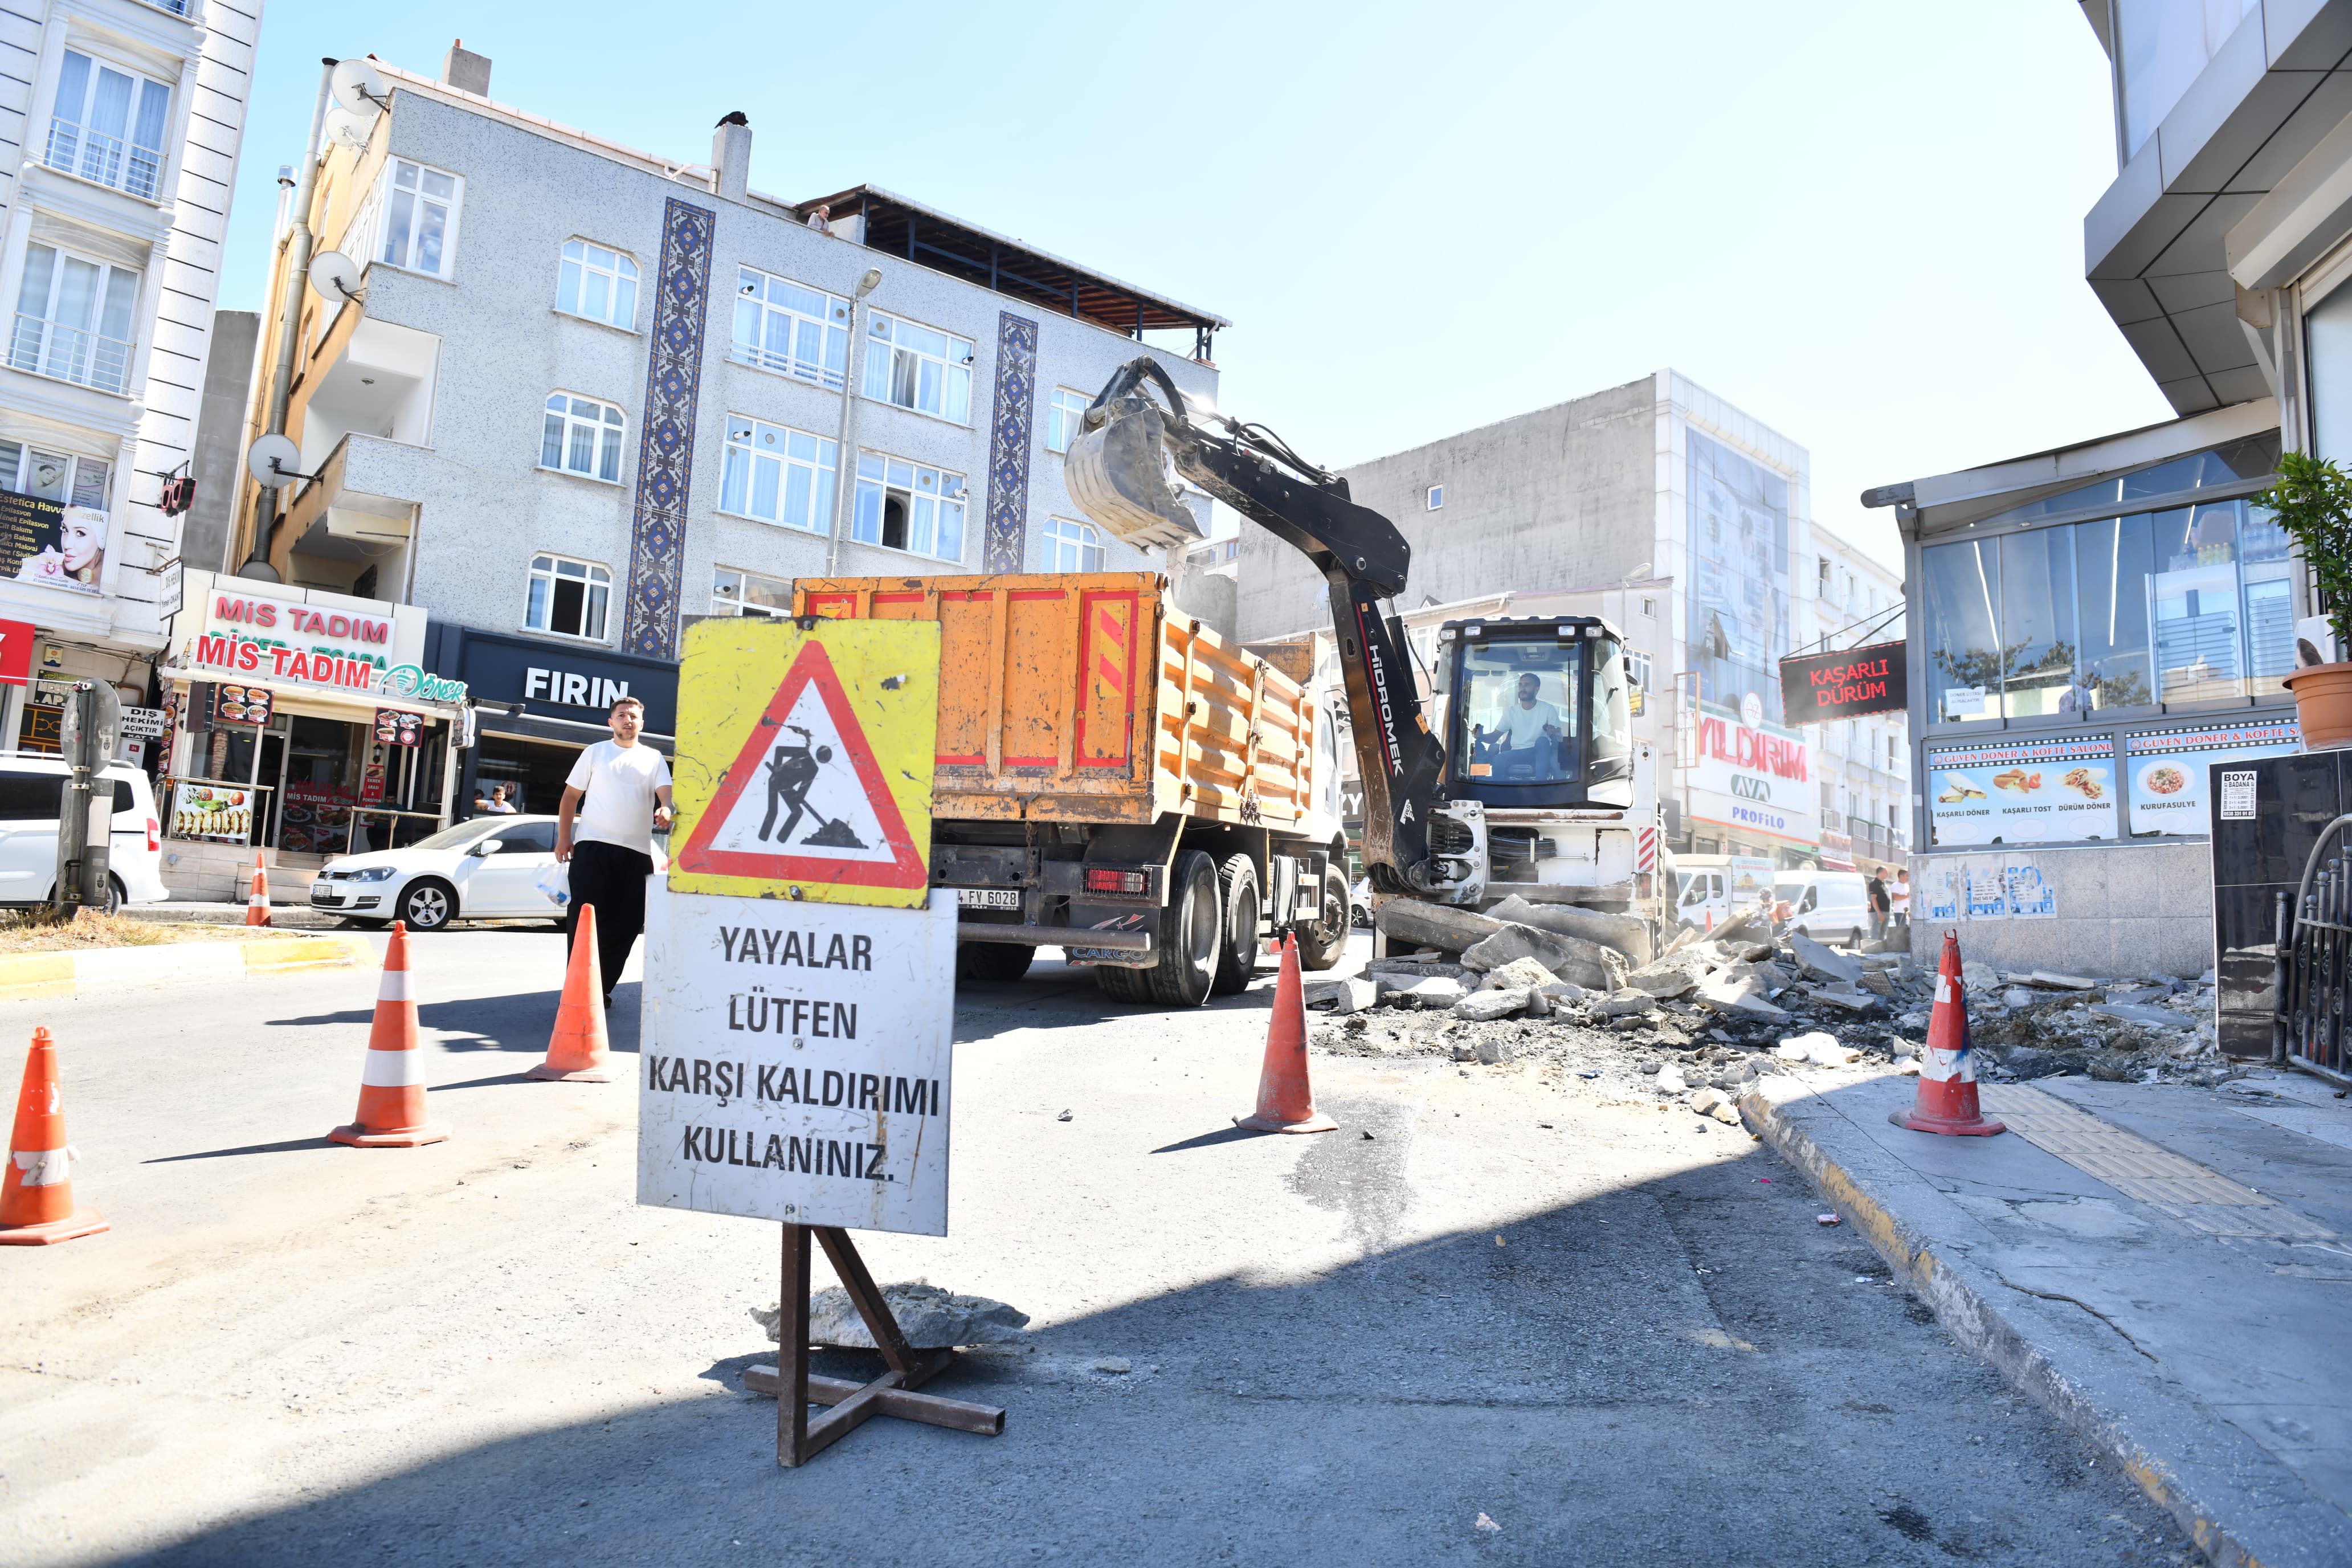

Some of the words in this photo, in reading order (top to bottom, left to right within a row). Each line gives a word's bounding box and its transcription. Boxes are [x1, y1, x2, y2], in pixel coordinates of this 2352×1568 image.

[19, 517, 49, 529] Epilasyon
[81, 512, 104, 523] zellik
[11, 524, 32, 534] Bakımı
[14, 533, 35, 543] Bakımı
[15, 542, 38, 552] Makyaj
[288, 607, 388, 644] TADIM
[196, 633, 259, 671] MİS
[270, 647, 371, 689] TADIM
[1810, 659, 1889, 688] KAŞARLI
[525, 667, 629, 709] FIRIN
[1817, 680, 1886, 707] DÜRÜM
[130, 708, 158, 718] DİŞ
[121, 716, 164, 726] HEKİMİ
[124, 725, 158, 734] AÇIKTIR
[2143, 737, 2181, 749] GÜVEN
[2186, 732, 2228, 744] DÖNER
[2232, 732, 2241, 741] &
[2245, 726, 2284, 739] KÖFTE
[1692, 712, 1807, 782] YILDIRIM
[1944, 753, 1978, 763] GÜVEN
[1981, 749, 2018, 761] DÖNER
[2022, 749, 2029, 757] &
[2032, 746, 2066, 756] KÖFTE
[2071, 742, 2114, 753] SALONU
[2224, 773, 2255, 781] BOYA
[1734, 775, 1770, 803] AVM
[287, 791, 301, 801] MİS
[303, 794, 326, 803] TADIM
[2002, 806, 2032, 815] KAŞARLI
[2141, 800, 2196, 810] KURUFASULYE
[1937, 809, 1965, 818] KAŞARLI
[969, 891, 982, 904] FV
[987, 891, 1016, 905] 6028
[719, 926, 873, 971] YAYALAR
[1072, 946, 1146, 960] CARGO
[729, 986, 857, 1040] LÜTFEN
[649, 1055, 742, 1108] KARŞI
[757, 1064, 939, 1117] KALDIRIMI
[683, 1125, 895, 1182] KULLANINIZ.
